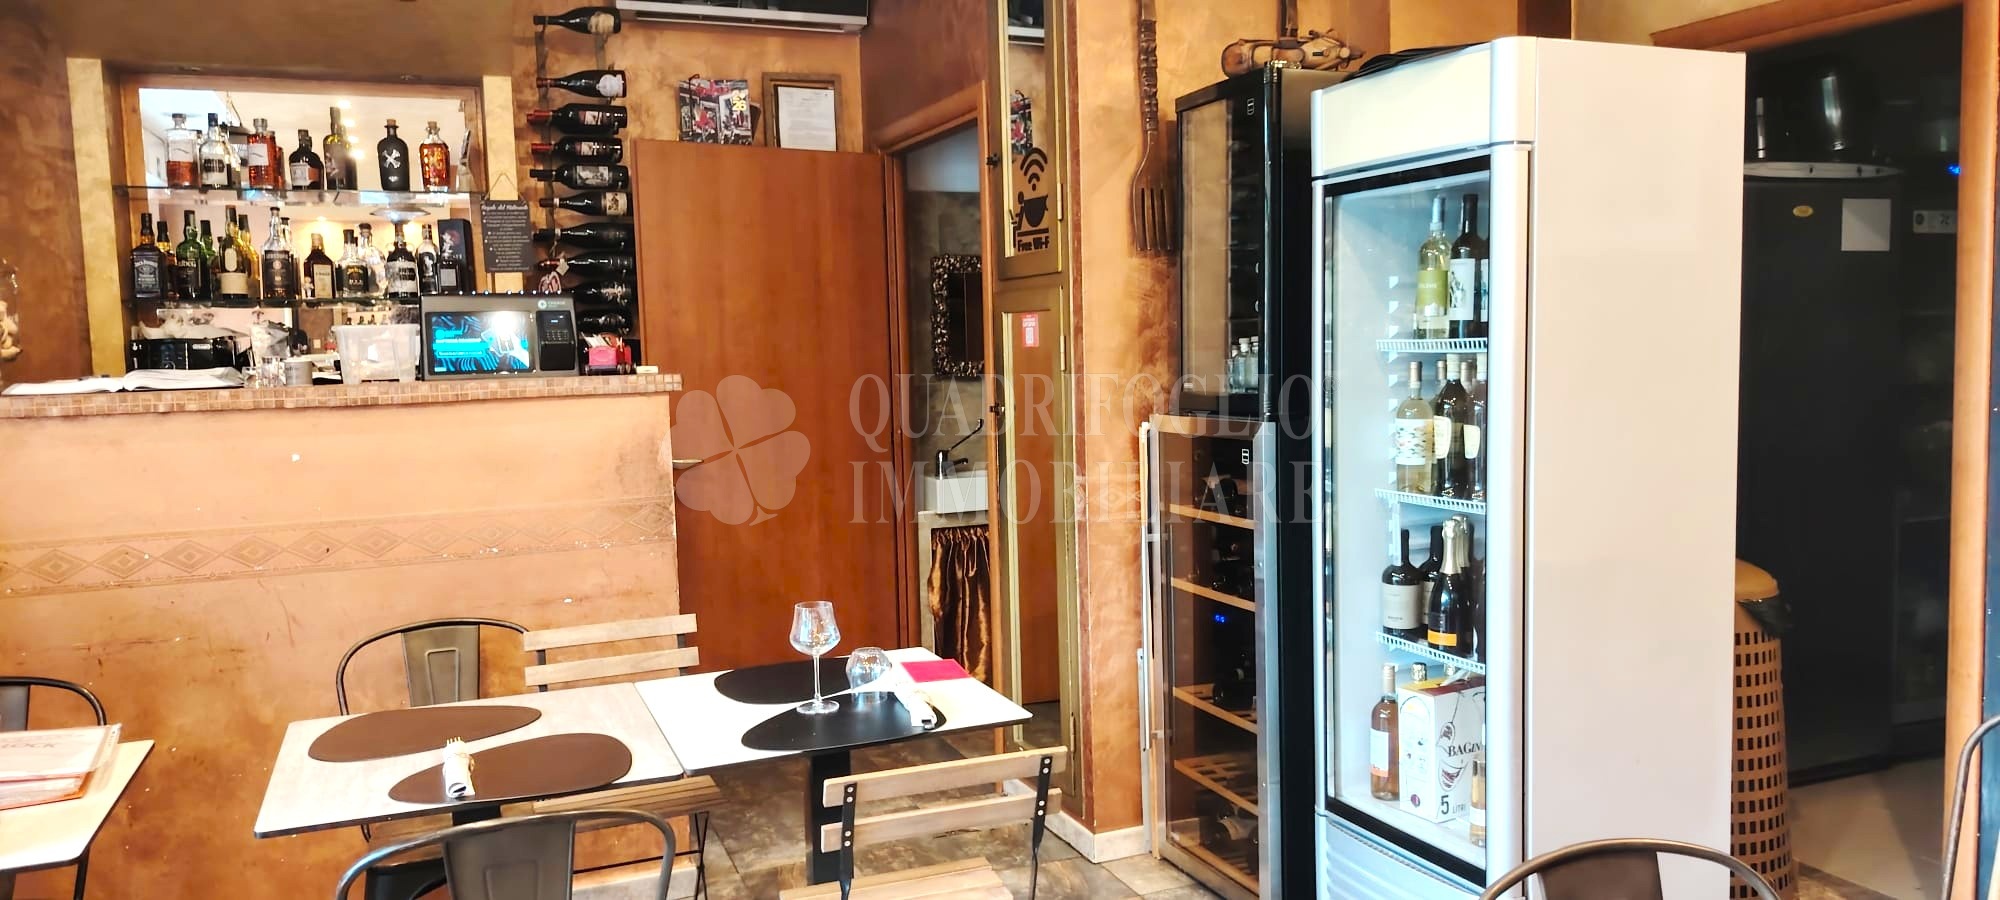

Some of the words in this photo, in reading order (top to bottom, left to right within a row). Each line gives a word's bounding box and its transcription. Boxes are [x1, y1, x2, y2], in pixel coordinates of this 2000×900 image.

[1018, 239, 1032, 252] Free
[1033, 236, 1049, 249] Wi-F
[1440, 794, 1449, 815] 5
